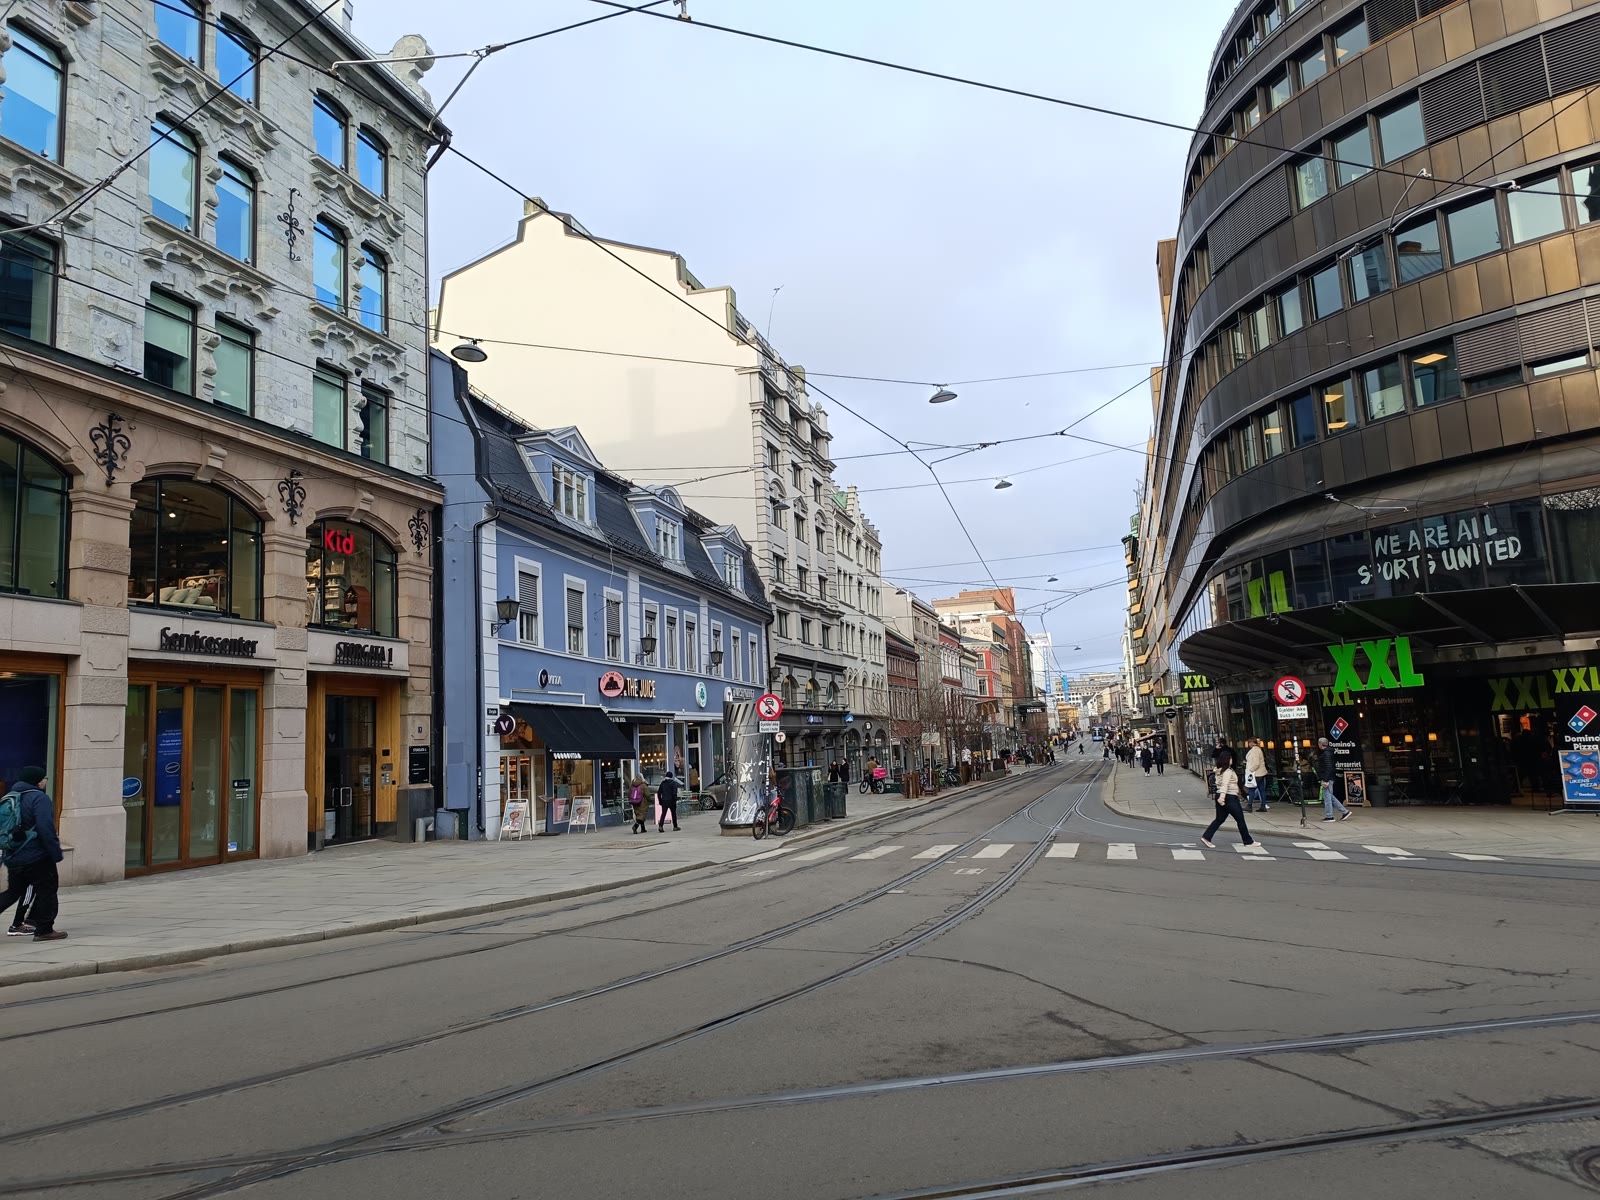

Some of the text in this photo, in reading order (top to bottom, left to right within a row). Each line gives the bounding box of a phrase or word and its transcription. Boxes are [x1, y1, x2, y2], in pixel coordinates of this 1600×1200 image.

[325, 530, 354, 555] Kid
[1375, 514, 1498, 557] WE ARE ALL
[1442, 536, 1522, 571] UNITED
[160, 627, 258, 655] Servicesenter
[336, 642, 386, 664] STORGATA
[1328, 637, 1424, 693] XXL
[547, 674, 562, 685] VITA
[627, 678, 638, 697] THE
[640, 679, 656, 698] JUICE
[1183, 675, 1210, 689] XXL
[1552, 667, 1600, 693] XXL
[1155, 697, 1170, 706] XXL
[1321, 687, 1354, 707] XXL
[1488, 675, 1555, 711] XXL
